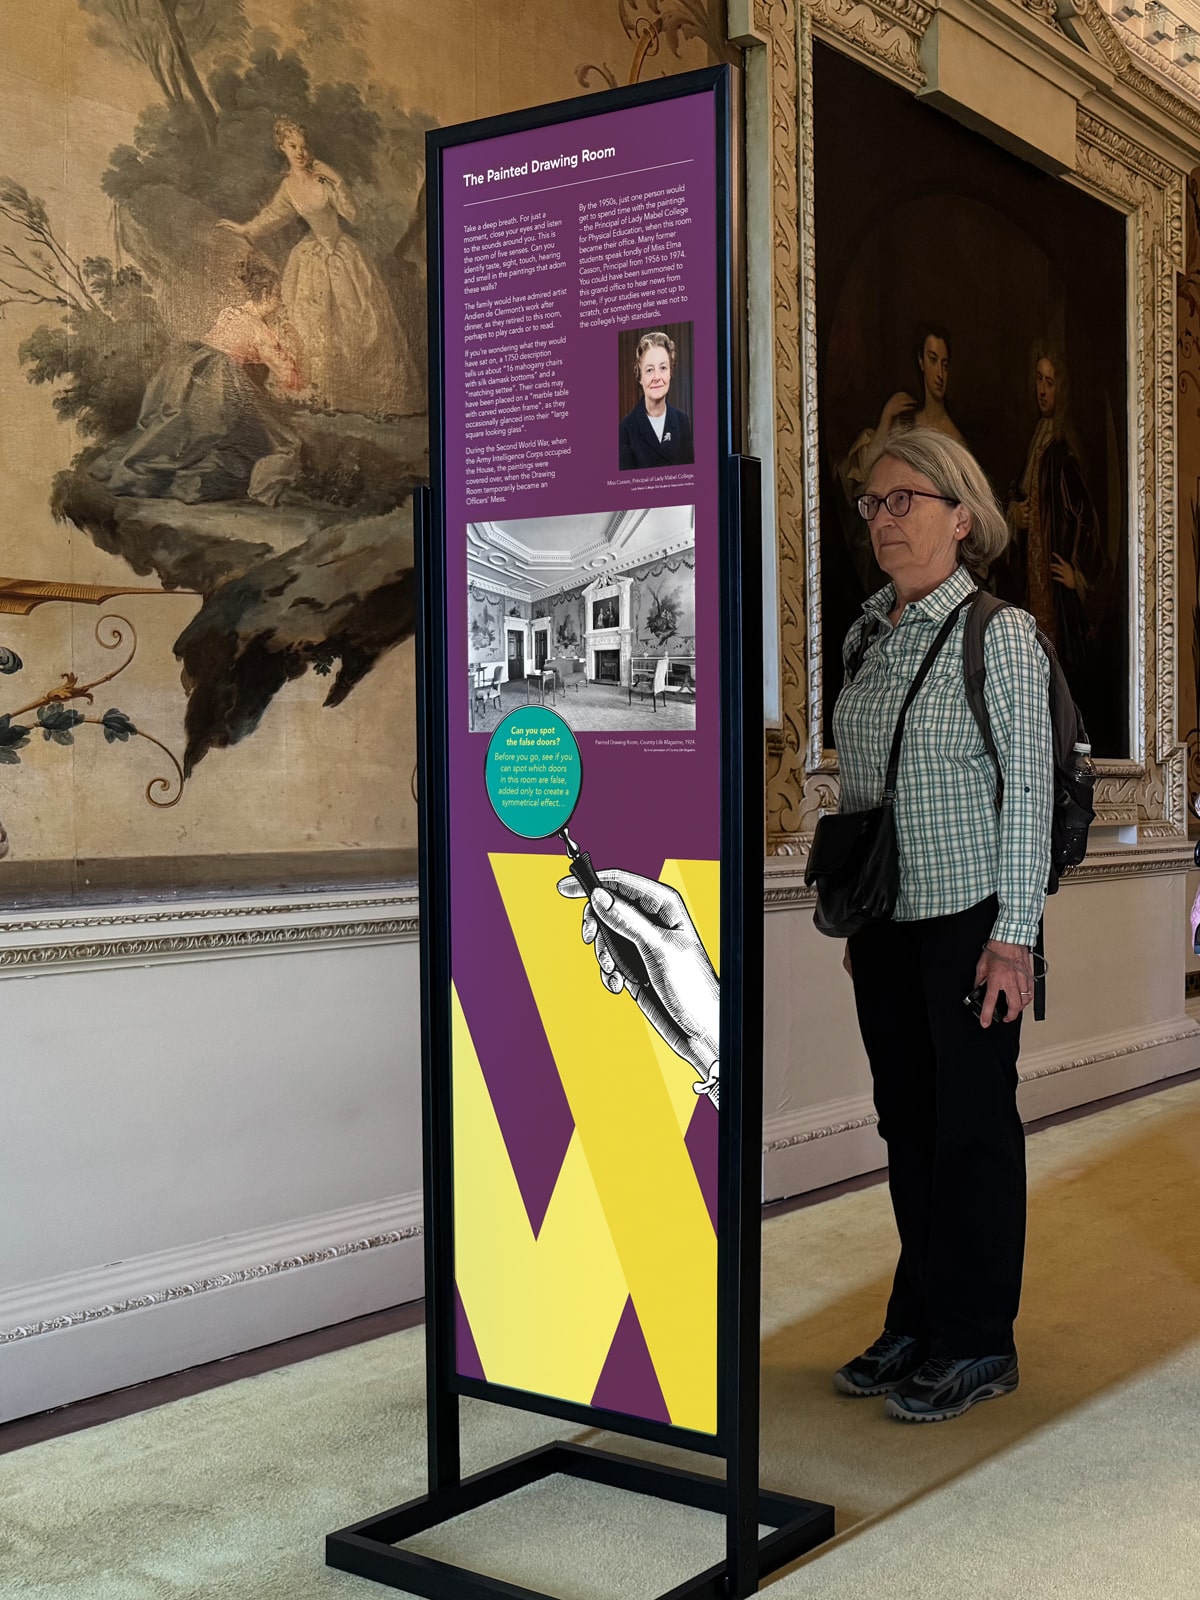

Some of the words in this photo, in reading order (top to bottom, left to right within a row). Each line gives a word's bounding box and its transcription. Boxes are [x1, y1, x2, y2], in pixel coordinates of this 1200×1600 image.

[463, 174, 484, 187] The
[488, 163, 528, 182] Painted
[532, 154, 578, 173] Drawing
[582, 147, 615, 162] Room
[579, 204, 586, 212] By
[599, 198, 617, 207] 1950s,
[619, 196, 629, 205] just
[644, 190, 665, 201] person
[666, 184, 685, 194] would
[579, 215, 589, 224] get
[598, 208, 616, 220] spend
[632, 203, 644, 212] with
[646, 201, 656, 209] the
[657, 197, 685, 209] paintings
[595, 218, 619, 229] Principal
[621, 216, 627, 225] of
[628, 214, 643, 223] Lady
[644, 210, 663, 220] Mabel
[664, 207, 688, 216] College
[464, 225, 476, 233] Take
[483, 222, 497, 230] deep
[499, 217, 518, 226] breath.
[531, 213, 541, 222] just
[464, 234, 488, 243] moment,
[506, 228, 518, 238] your
[520, 226, 533, 234] eyes
[534, 221, 545, 230] and
[579, 235, 587, 243] for
[588, 230, 611, 242] Physical
[613, 226, 643, 237] Education,
[645, 223, 662, 231] when
[663, 220, 674, 228] this
[675, 218, 691, 226] room
[579, 245, 602, 254] became
[604, 241, 617, 249] their
[618, 238, 636, 247] office.
[638, 235, 654, 243] Many
[656, 232, 676, 240] former
[579, 255, 604, 264] students
[605, 250, 622, 262] speak
[623, 247, 642, 256] fondly
[643, 245, 650, 253] of
[579, 267, 602, 275] Casson,
[603, 260, 628, 271] Principal
[645, 255, 660, 263] 1956
[670, 250, 686, 259] 1974.
[591, 274, 607, 283] could
[641, 263, 675, 275] summoned
[591, 285, 608, 296] grand
[610, 283, 626, 291] office
[650, 277, 665, 285] news
[667, 274, 680, 282] from
[476, 300, 493, 309] family
[494, 296, 511, 306] would
[527, 290, 551, 300] admired
[604, 296, 617, 305] your
[619, 292, 640, 301] studies
[580, 308, 601, 317] scratch,
[610, 303, 641, 313] something
[643, 300, 655, 308] else
[617, 314, 630, 324] high
[631, 310, 661, 320] standards.
[466, 447, 484, 455] During
[496, 442, 517, 451] Second
[519, 440, 536, 449] World
[511, 726, 524, 734] Can
[540, 727, 555, 736] spot
[507, 738, 517, 746] the
[519, 738, 535, 746] false
[537, 737, 560, 746] doors?
[495, 752, 515, 760] Before
[530, 755, 540, 763] go,
[555, 752, 560, 760] if
[513, 765, 527, 774] spot
[528, 764, 546, 772] which
[550, 775, 566, 784] false,
[498, 787, 519, 795] added
[520, 787, 533, 796] only
[502, 798, 539, 808] symmetrical
